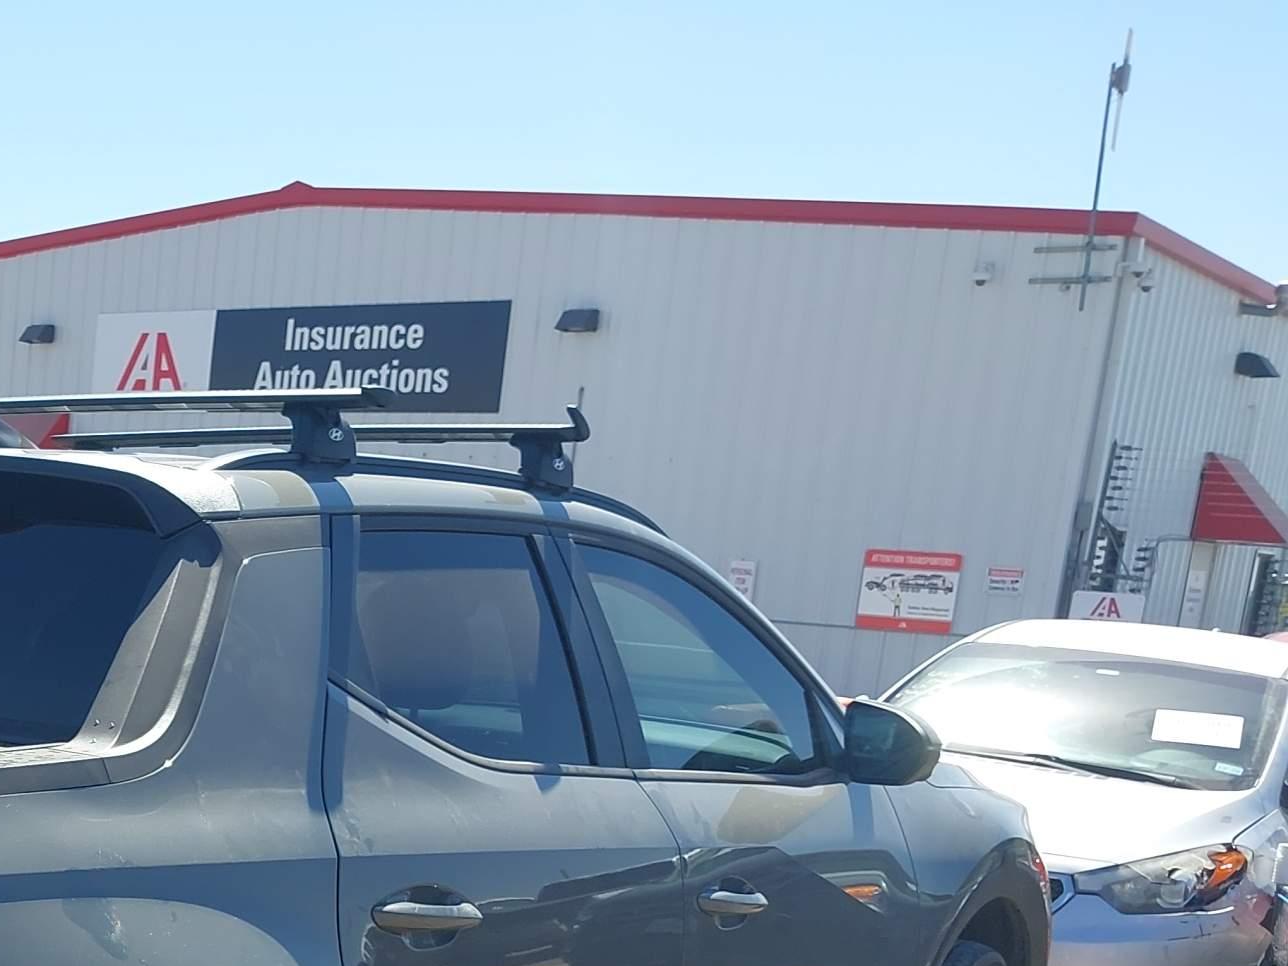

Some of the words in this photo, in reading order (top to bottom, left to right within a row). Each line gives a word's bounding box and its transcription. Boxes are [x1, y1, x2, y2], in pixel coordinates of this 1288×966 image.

[285, 318, 424, 351] Insurance
[253, 361, 316, 390] Auto
[323, 359, 449, 394] Auctions
